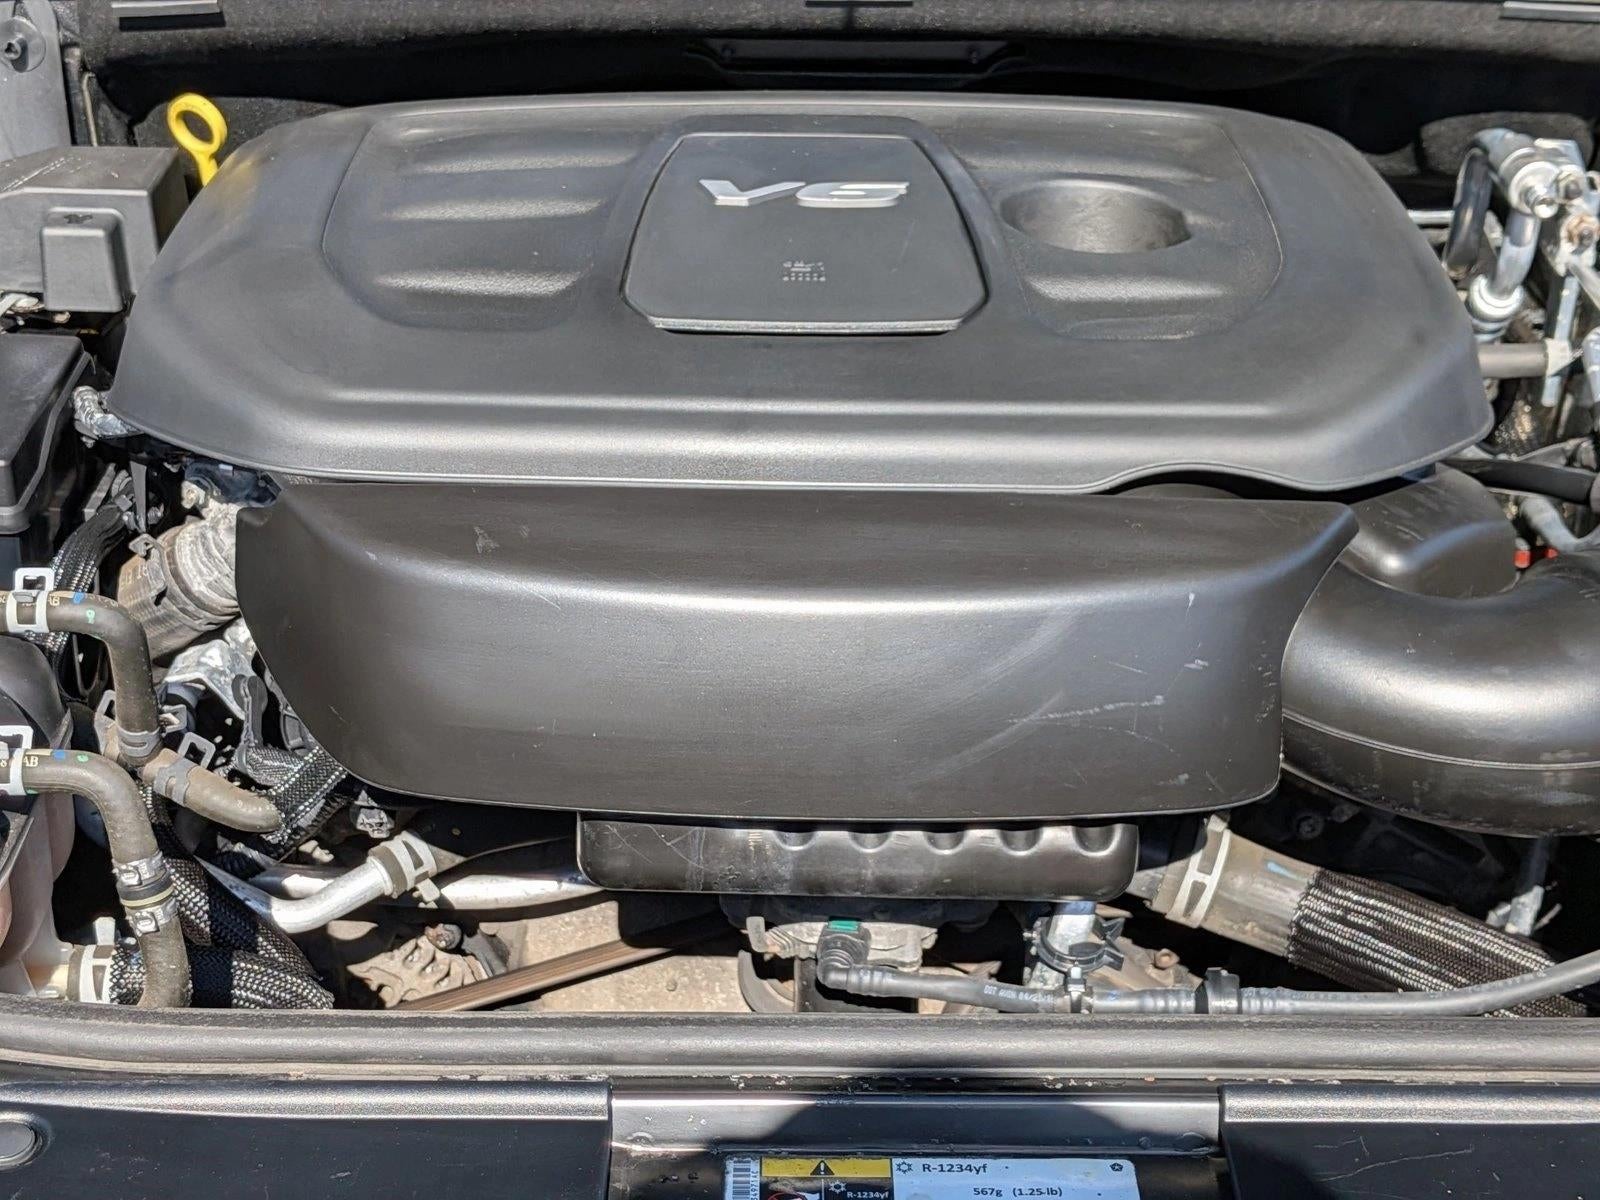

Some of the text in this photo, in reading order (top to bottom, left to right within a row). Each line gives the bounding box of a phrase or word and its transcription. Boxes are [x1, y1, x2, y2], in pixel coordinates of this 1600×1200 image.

[699, 179, 910, 208] V6
[922, 1163, 988, 1175] R-1234yf
[846, 1190, 889, 1199] R-1234yf
[973, 1187, 1003, 1197] 567g
